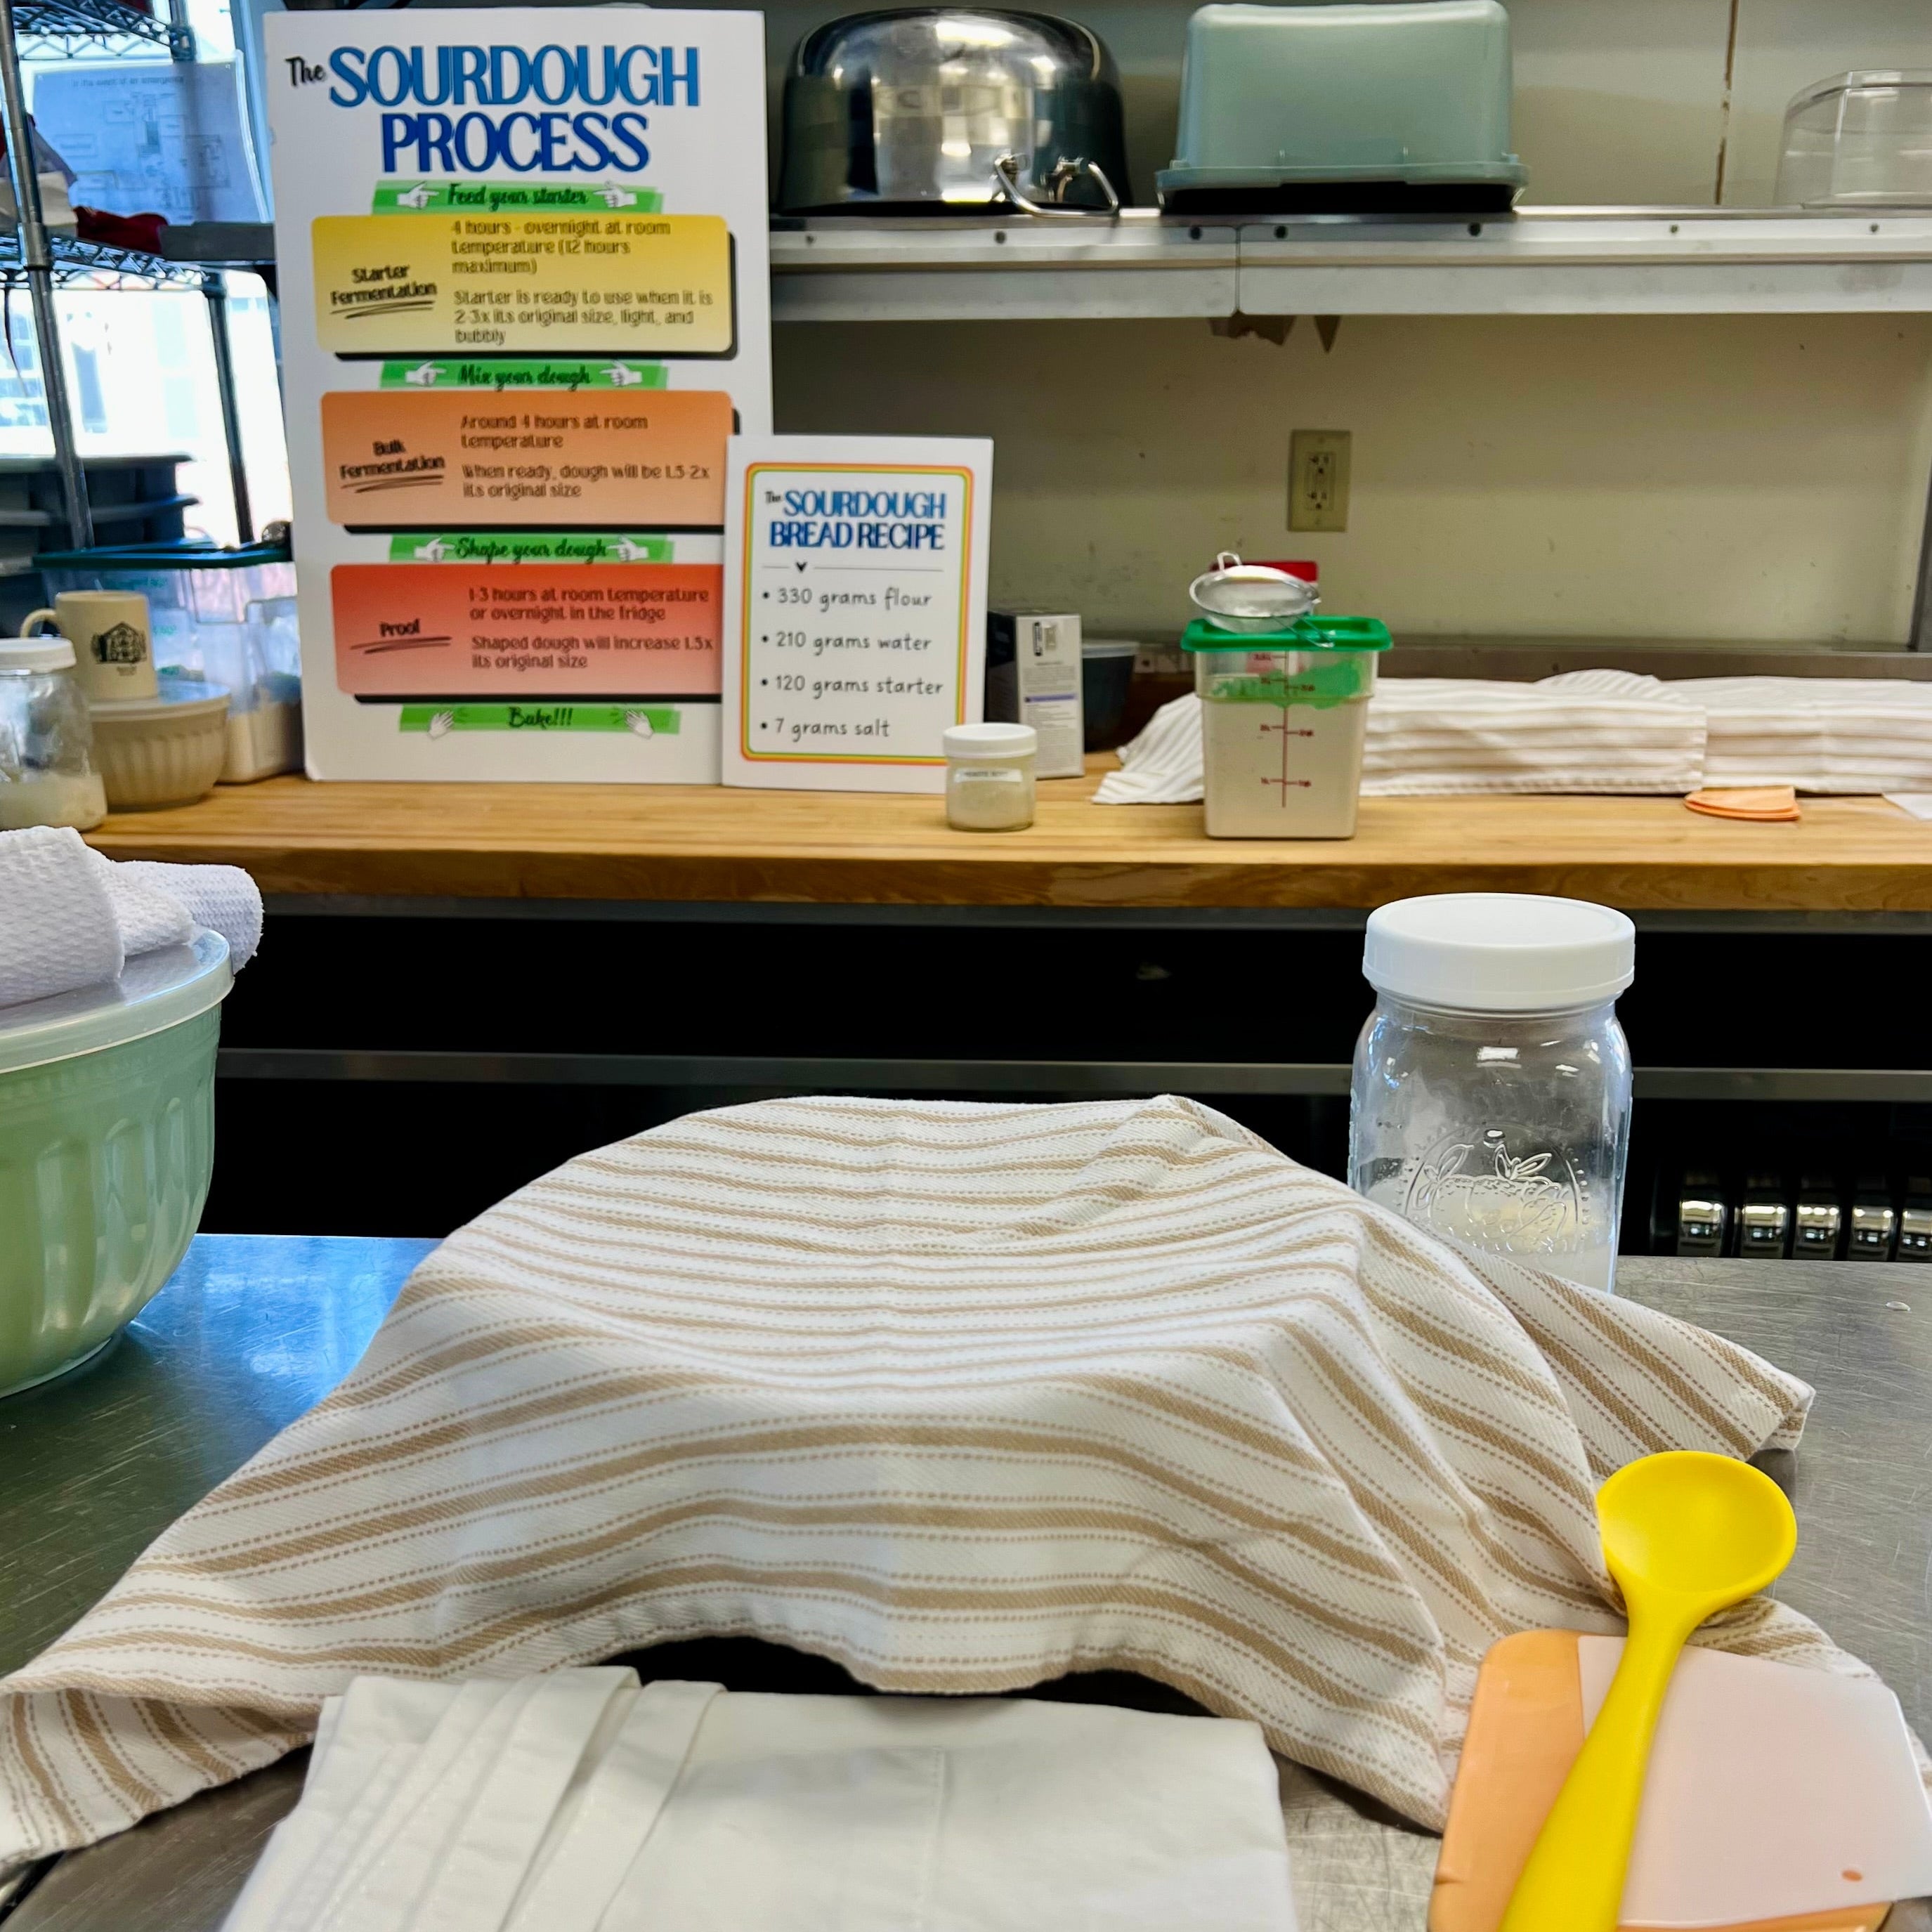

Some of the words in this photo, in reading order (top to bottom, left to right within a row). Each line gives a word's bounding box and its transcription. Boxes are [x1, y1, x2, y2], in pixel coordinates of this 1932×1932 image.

[285, 56, 327, 88] The
[328, 45, 700, 107] SOURDOUGH
[381, 111, 650, 173] PROCESS
[448, 183, 486, 205] Feed
[489, 191, 530, 212] your
[533, 186, 589, 204] starter
[451, 221, 462, 235] 4
[465, 220, 511, 235] hours
[523, 220, 601, 238] overnight
[605, 221, 622, 235] at
[626, 221, 671, 235] room
[452, 240, 555, 257] temperature
[558, 239, 581, 256] (12
[584, 240, 631, 254] hours
[352, 265, 410, 283] Starter
[452, 258, 537, 275] maximum)
[329, 281, 438, 306] Fermentation
[453, 289, 511, 306] Starter
[516, 289, 531, 305] is
[533, 289, 579, 307] ready
[582, 290, 601, 305] to
[603, 294, 632, 305] use
[635, 289, 679, 305] when
[683, 290, 696, 305] it
[698, 290, 714, 305] is
[493, 309, 515, 324] its
[518, 309, 578, 327] original
[664, 309, 694, 325] and
[455, 328, 506, 346] bubbly
[459, 364, 492, 385] Mix
[494, 372, 533, 392] your
[537, 364, 592, 392] dough
[461, 415, 516, 429] Around
[521, 415, 530, 429] 4
[534, 415, 580, 429] hours
[584, 415, 602, 429] at
[604, 415, 648, 429] room
[461, 434, 564, 450] temperature
[339, 455, 446, 479] Fermentation
[462, 464, 505, 479] When
[559, 464, 608, 483] dough
[611, 464, 639, 479] will
[641, 464, 662, 479] be
[463, 483, 485, 498] its
[488, 483, 547, 501] original
[549, 483, 582, 498] size
[764, 491, 781, 505] The
[783, 490, 946, 518] SOURDOUGH
[770, 521, 852, 548] BREAD
[856, 523, 945, 550] RECIPE
[457, 537, 509, 565] Shape
[511, 544, 551, 566] your
[554, 537, 607, 566] dough
[492, 587, 539, 603] hours
[541, 587, 557, 603] at
[561, 588, 604, 602] room
[607, 587, 710, 604] temperature
[777, 587, 813, 605] 330
[819, 593, 877, 613] grams
[884, 587, 932, 611] flour
[469, 607, 485, 621] or
[490, 606, 566, 624] overnight
[570, 606, 585, 620] in
[588, 606, 615, 620] the
[619, 606, 665, 624] fridge
[379, 618, 420, 637] Proof
[471, 635, 529, 653] Shaped
[532, 635, 580, 654] dough
[584, 635, 610, 651] will
[614, 635, 681, 651] increase
[776, 632, 807, 648] 210
[813, 635, 870, 656] grams
[877, 634, 932, 651] water
[472, 653, 492, 668] its
[495, 653, 554, 672] original
[558, 653, 588, 668] size
[775, 675, 806, 691] 120
[812, 678, 869, 700] grams
[876, 676, 944, 695] starter
[507, 706, 573, 730] Bake!!!
[776, 718, 785, 734] 7
[792, 722, 847, 743] grams
[854, 718, 890, 737] salt
